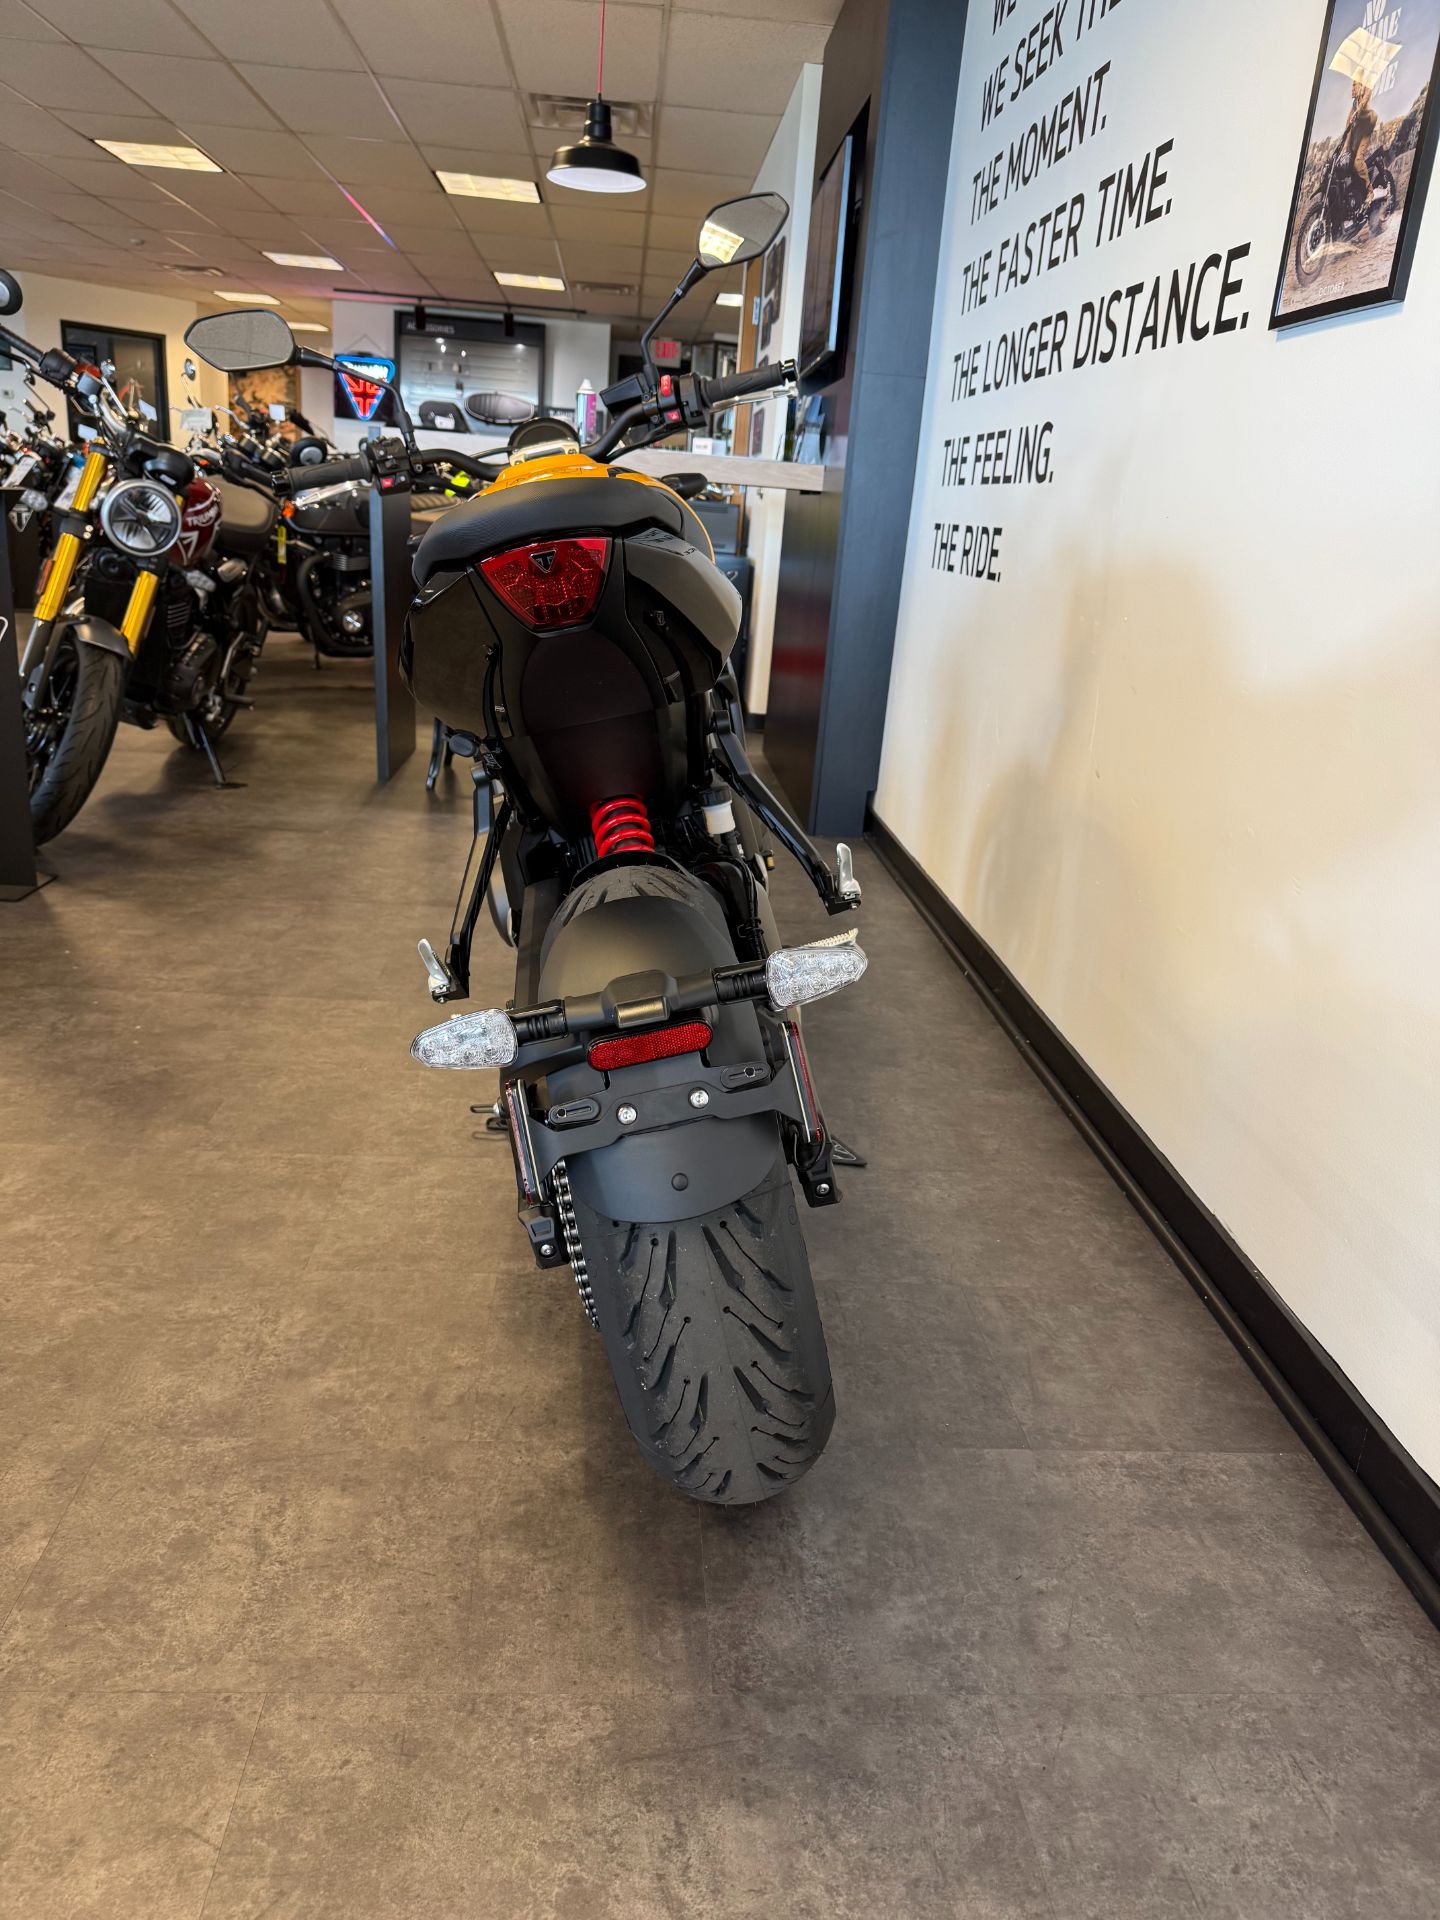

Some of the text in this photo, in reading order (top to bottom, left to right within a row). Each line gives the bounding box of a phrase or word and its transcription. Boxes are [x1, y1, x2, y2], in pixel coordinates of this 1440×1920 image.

[980, 54, 1010, 133] WE
[1010, 0, 1069, 101] SEEK
[969, 60, 1111, 227] THE MOMENT.
[961, 138, 1174, 316] THE FASTER TIME.
[951, 241, 1251, 403] THE LONGER DISTANCE.
[941, 421, 1054, 488] THE FEELING.
[931, 523, 1002, 583] THE RIDE.
